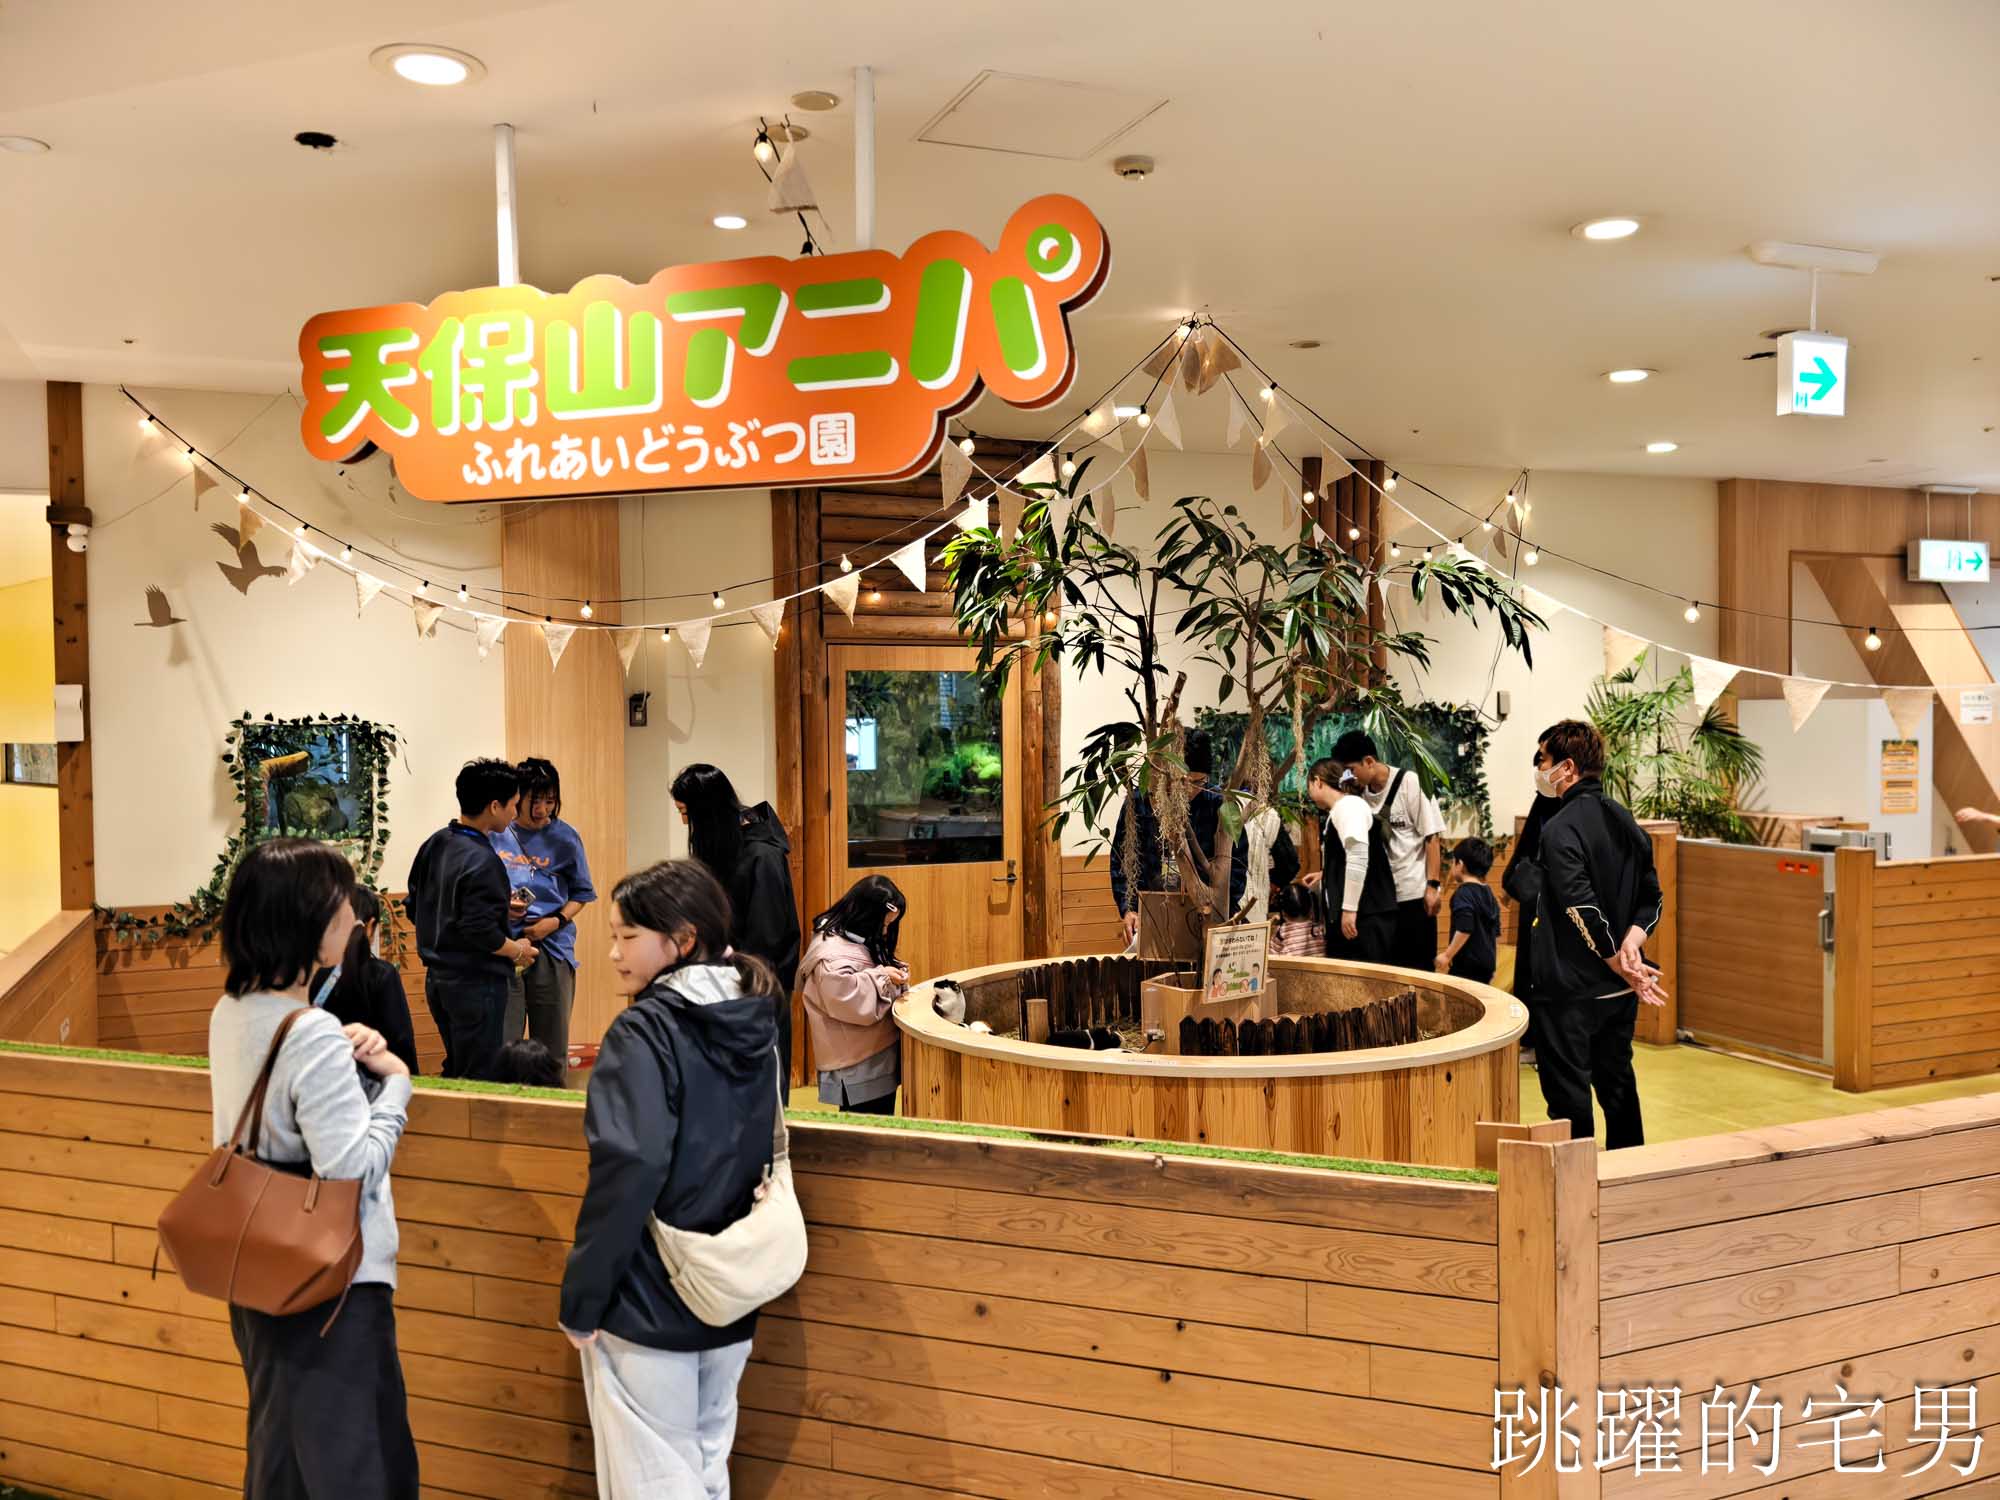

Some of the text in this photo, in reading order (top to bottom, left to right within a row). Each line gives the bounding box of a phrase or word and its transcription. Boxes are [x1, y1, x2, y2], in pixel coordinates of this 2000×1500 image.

[317, 223, 1081, 440] 天保山アニパ
[462, 412, 855, 486] ふれあいどうぶつ園
